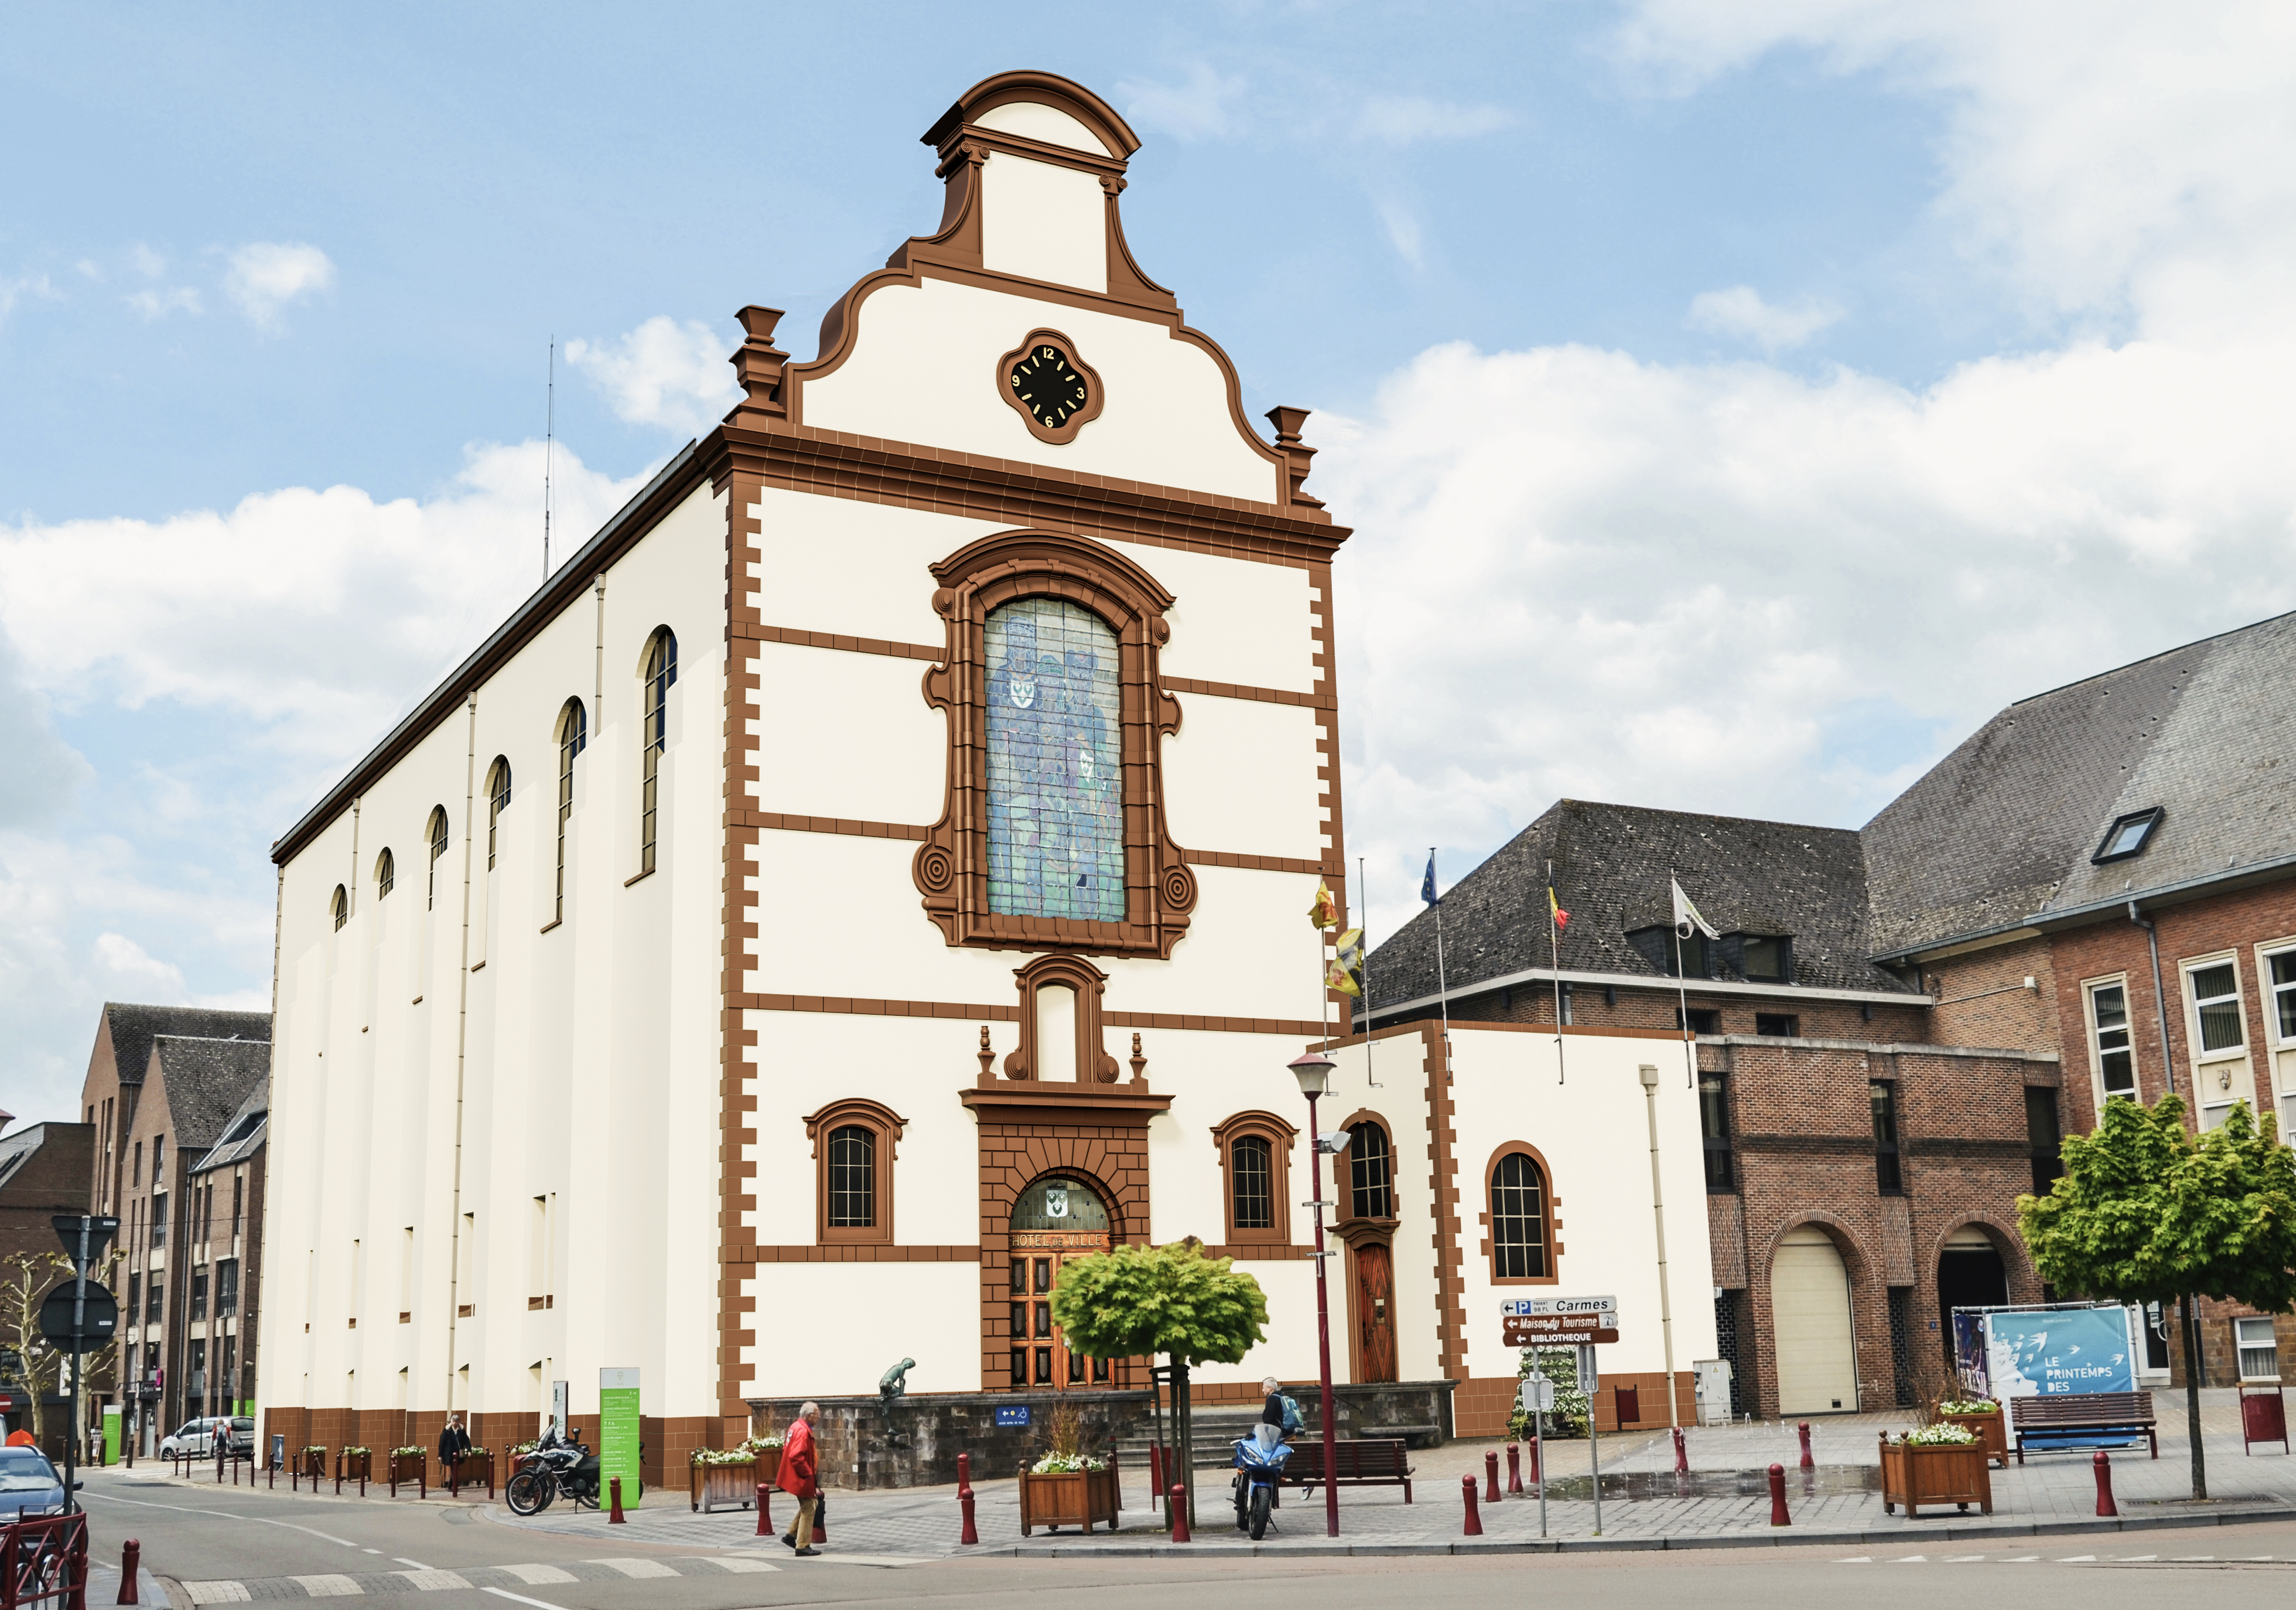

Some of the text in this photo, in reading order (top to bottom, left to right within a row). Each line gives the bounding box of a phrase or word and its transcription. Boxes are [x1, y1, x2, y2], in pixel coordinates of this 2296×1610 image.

[1043, 347, 1054, 360] 12
[1012, 375, 1020, 387] 9
[1076, 387, 1085, 400] 3
[1045, 415, 1054, 428] 6
[1012, 1234, 1102, 1247] HOTEL DE VILLE
[1518, 1301, 1529, 1314] P
[1556, 1300, 1608, 1311] Carmes
[1520, 1317, 1548, 1329] Maison
[1562, 1316, 1598, 1328] Tourisme
[1530, 1333, 1591, 1343] BIBLIOTHEQUE
[2045, 1356, 2059, 1367] LE
[2046, 1367, 2113, 1380] PRINTEMPS
[2047, 1382, 2070, 1393] DES
